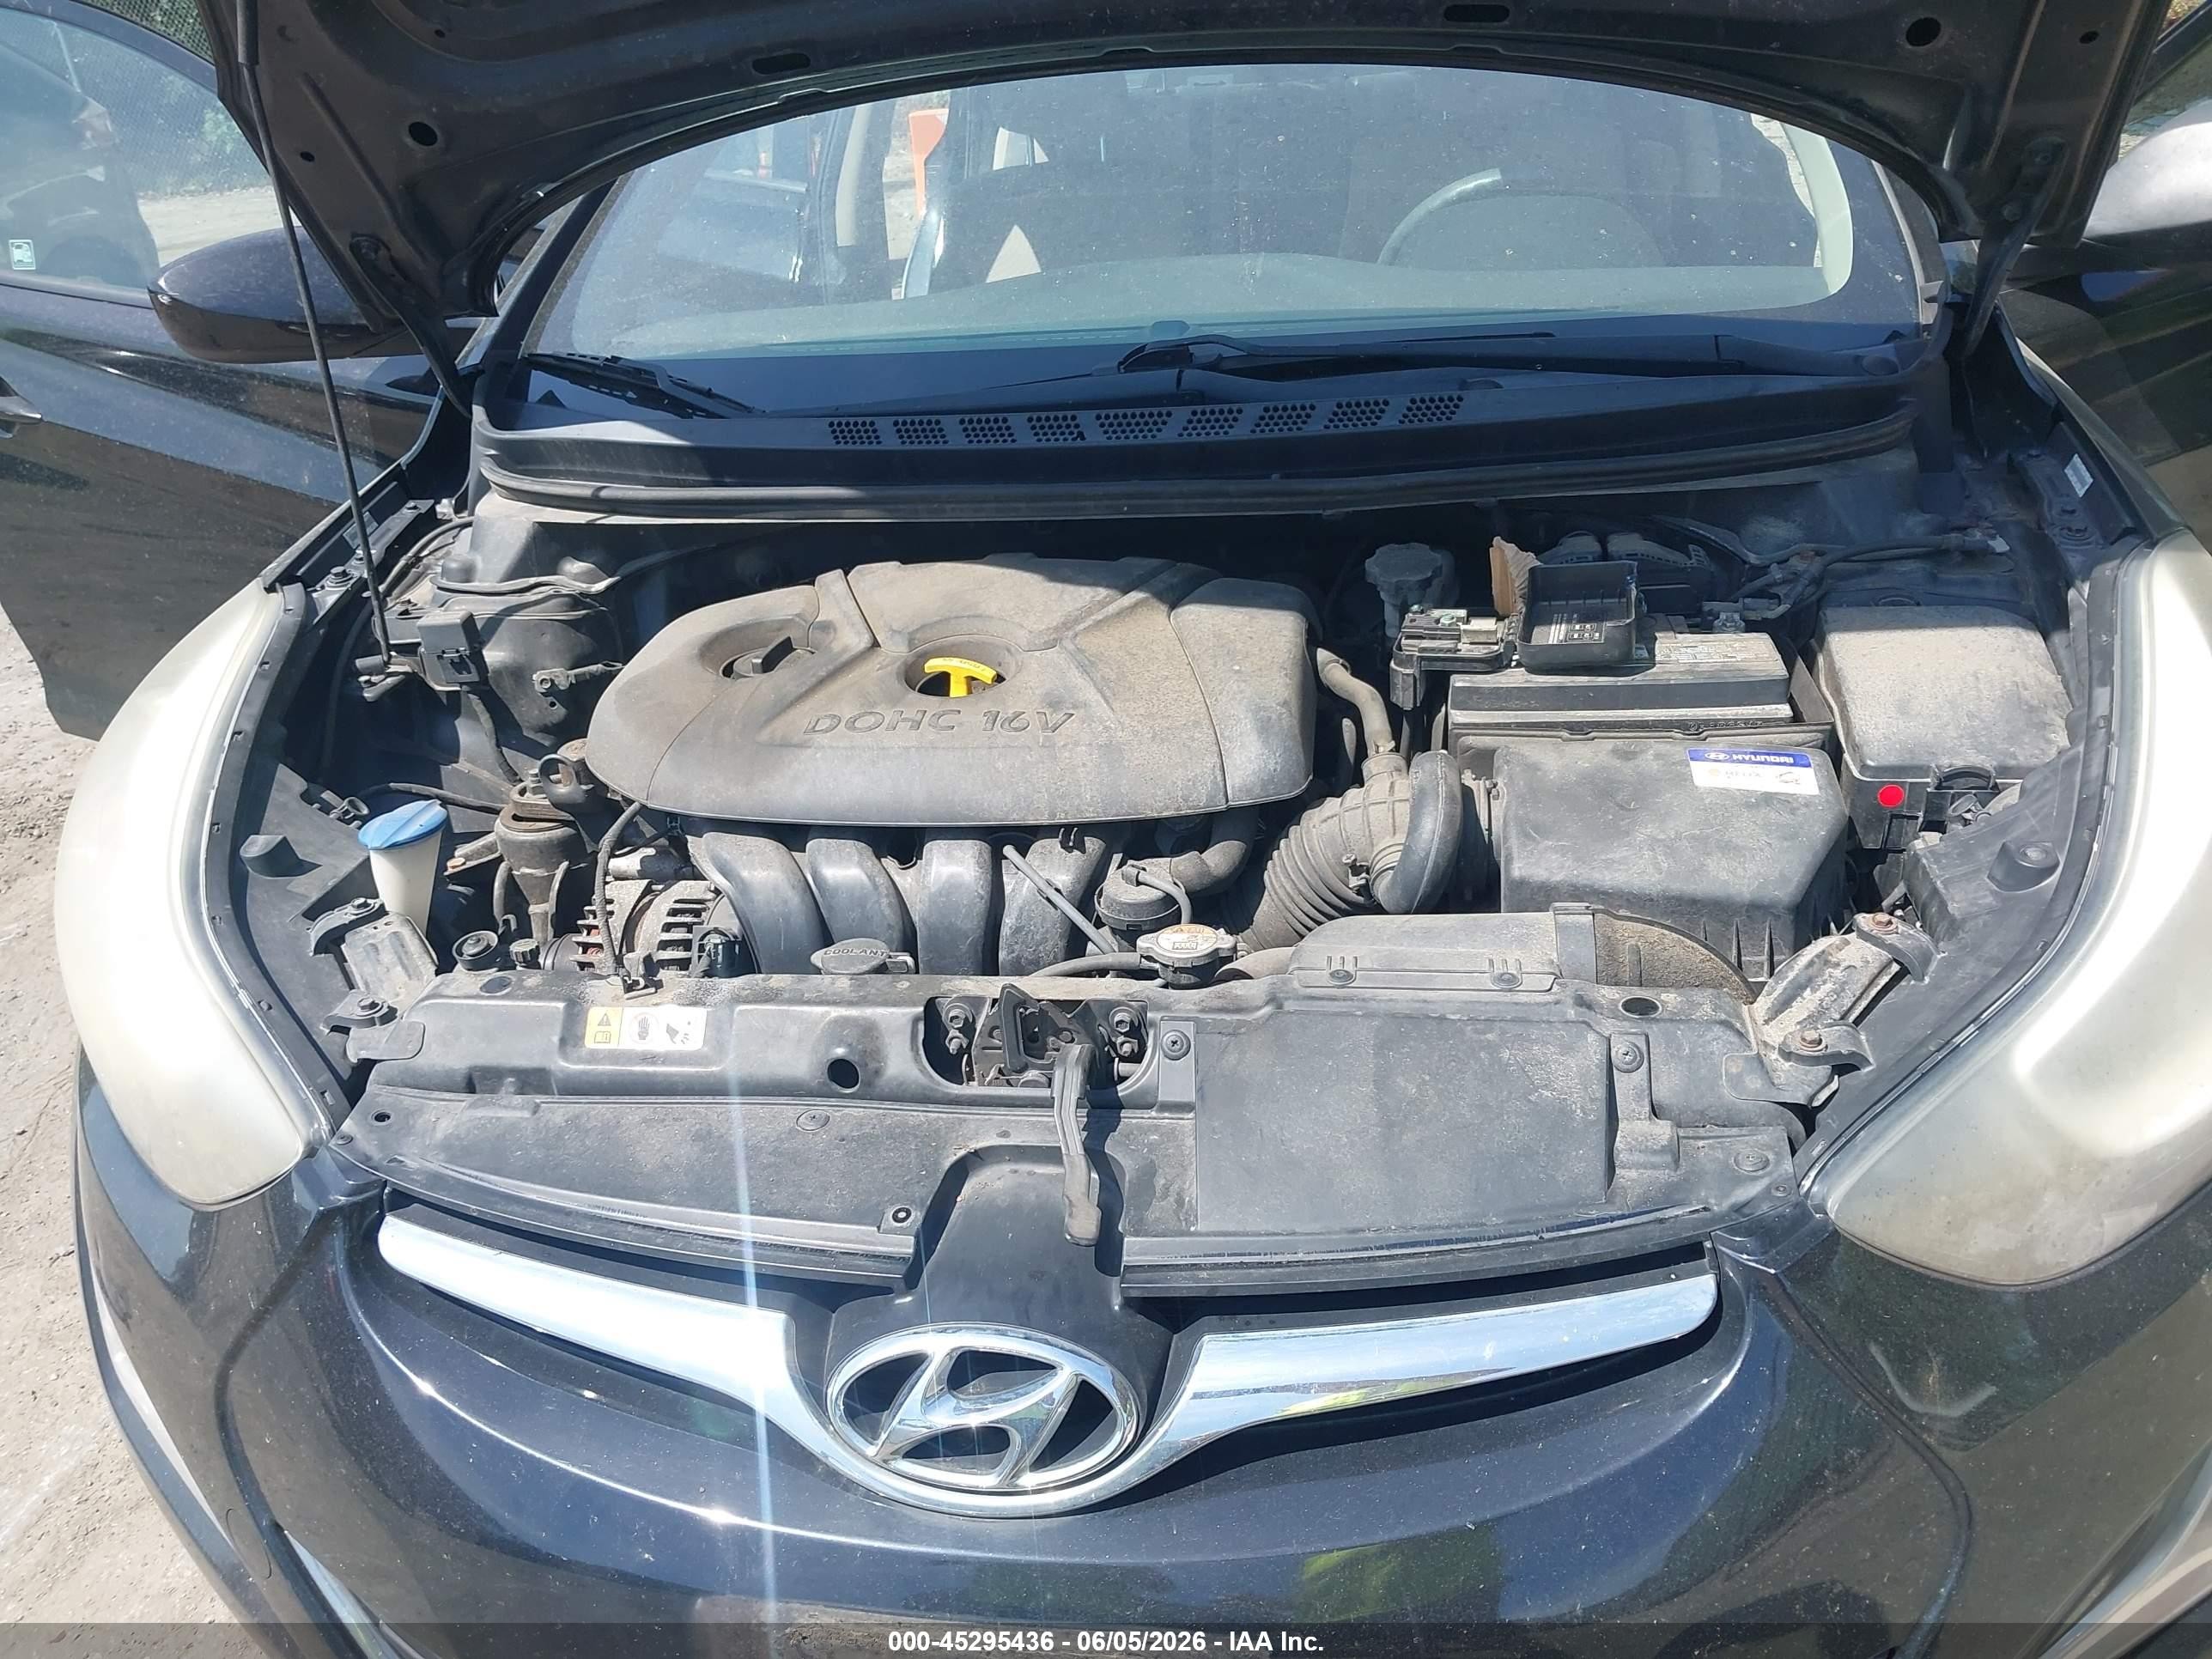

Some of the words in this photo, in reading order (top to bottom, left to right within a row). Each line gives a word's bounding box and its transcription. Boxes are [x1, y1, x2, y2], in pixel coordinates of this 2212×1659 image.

[804, 709, 961, 735] DOHC
[981, 710, 1074, 733] 16V
[1732, 753, 1795, 763] HYUNDAI
[823, 948, 888, 957] COOLANT
